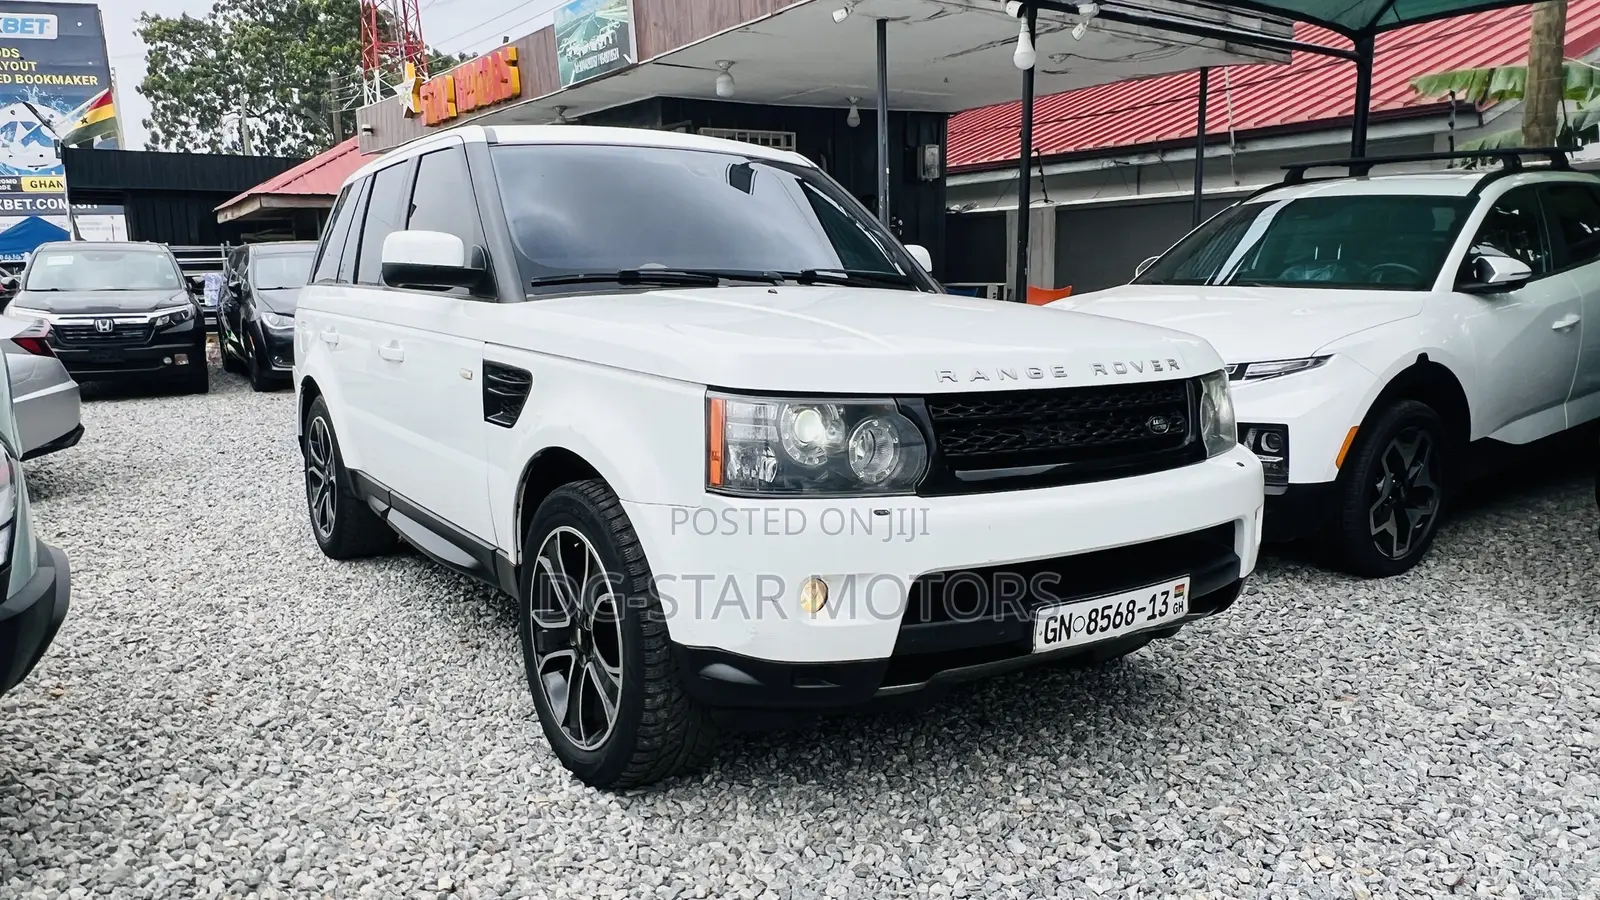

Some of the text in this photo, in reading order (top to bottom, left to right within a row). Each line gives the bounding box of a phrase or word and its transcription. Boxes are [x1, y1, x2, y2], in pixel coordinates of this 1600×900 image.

[0, 17, 50, 35] BET
[0, 47, 20, 58] DS
[0, 61, 37, 71] YOUT
[15, 74, 98, 85] BOOKMAKER
[934, 358, 1180, 383] RANGE ROVER
[1172, 600, 1184, 615] GH
